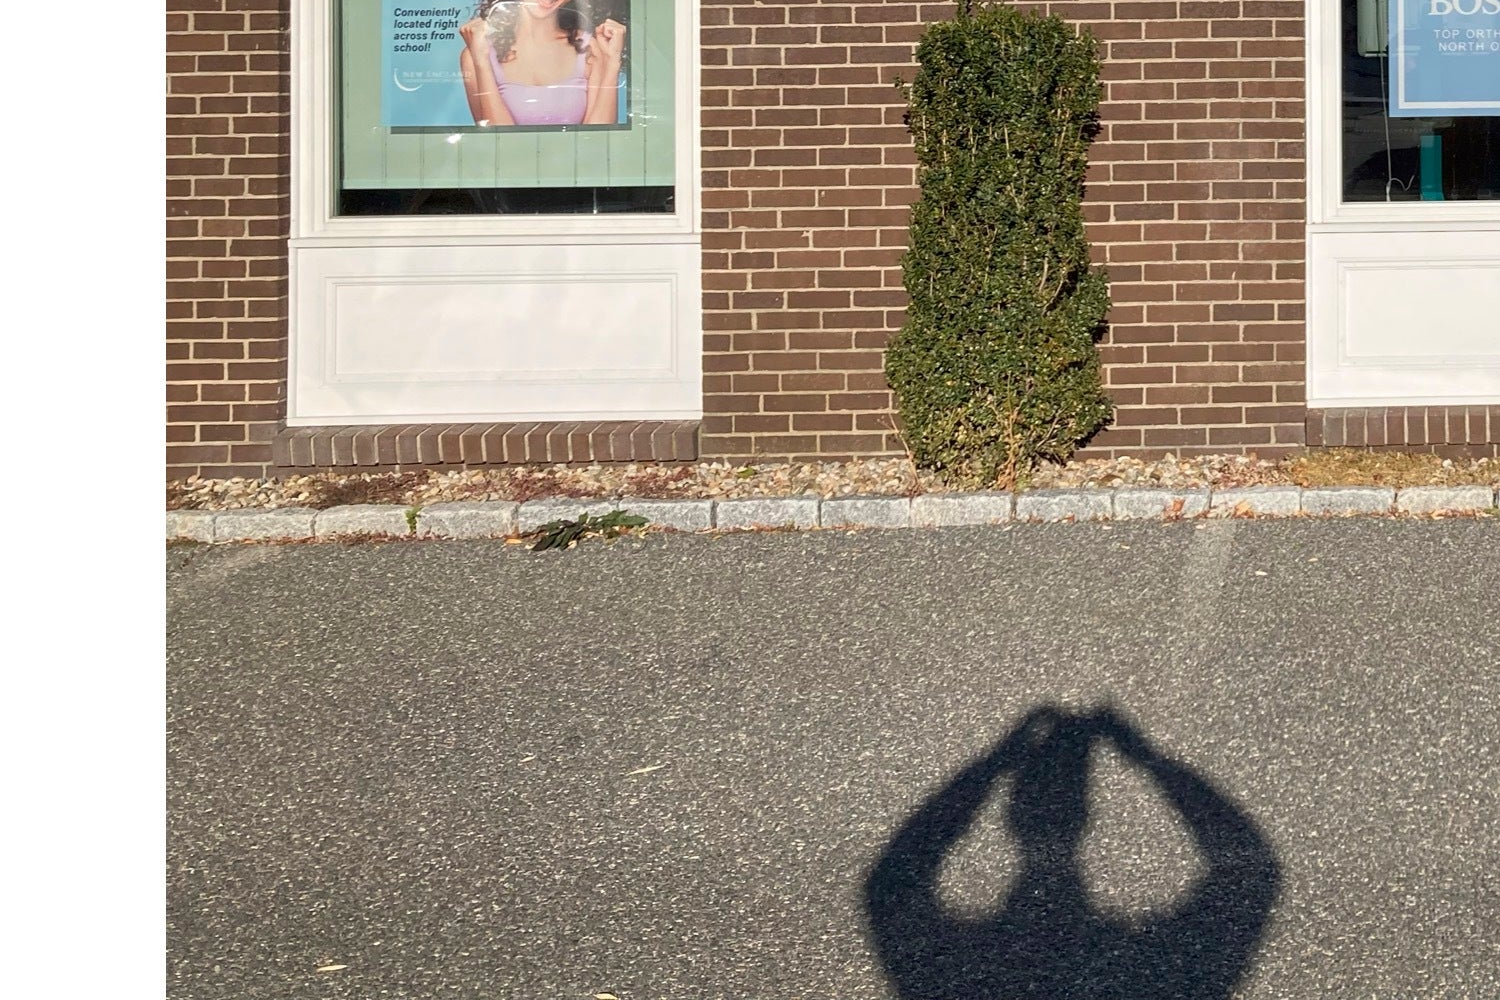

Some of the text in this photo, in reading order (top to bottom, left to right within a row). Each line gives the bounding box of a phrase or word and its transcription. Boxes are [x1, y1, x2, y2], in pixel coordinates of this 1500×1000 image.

[394, 8, 461, 18] Conveniently
[394, 19, 459, 30] located right
[394, 31, 455, 40] across from
[1434, 29, 1460, 39] TOP
[394, 43, 431, 52] school!
[1438, 41, 1485, 52] NORTH
